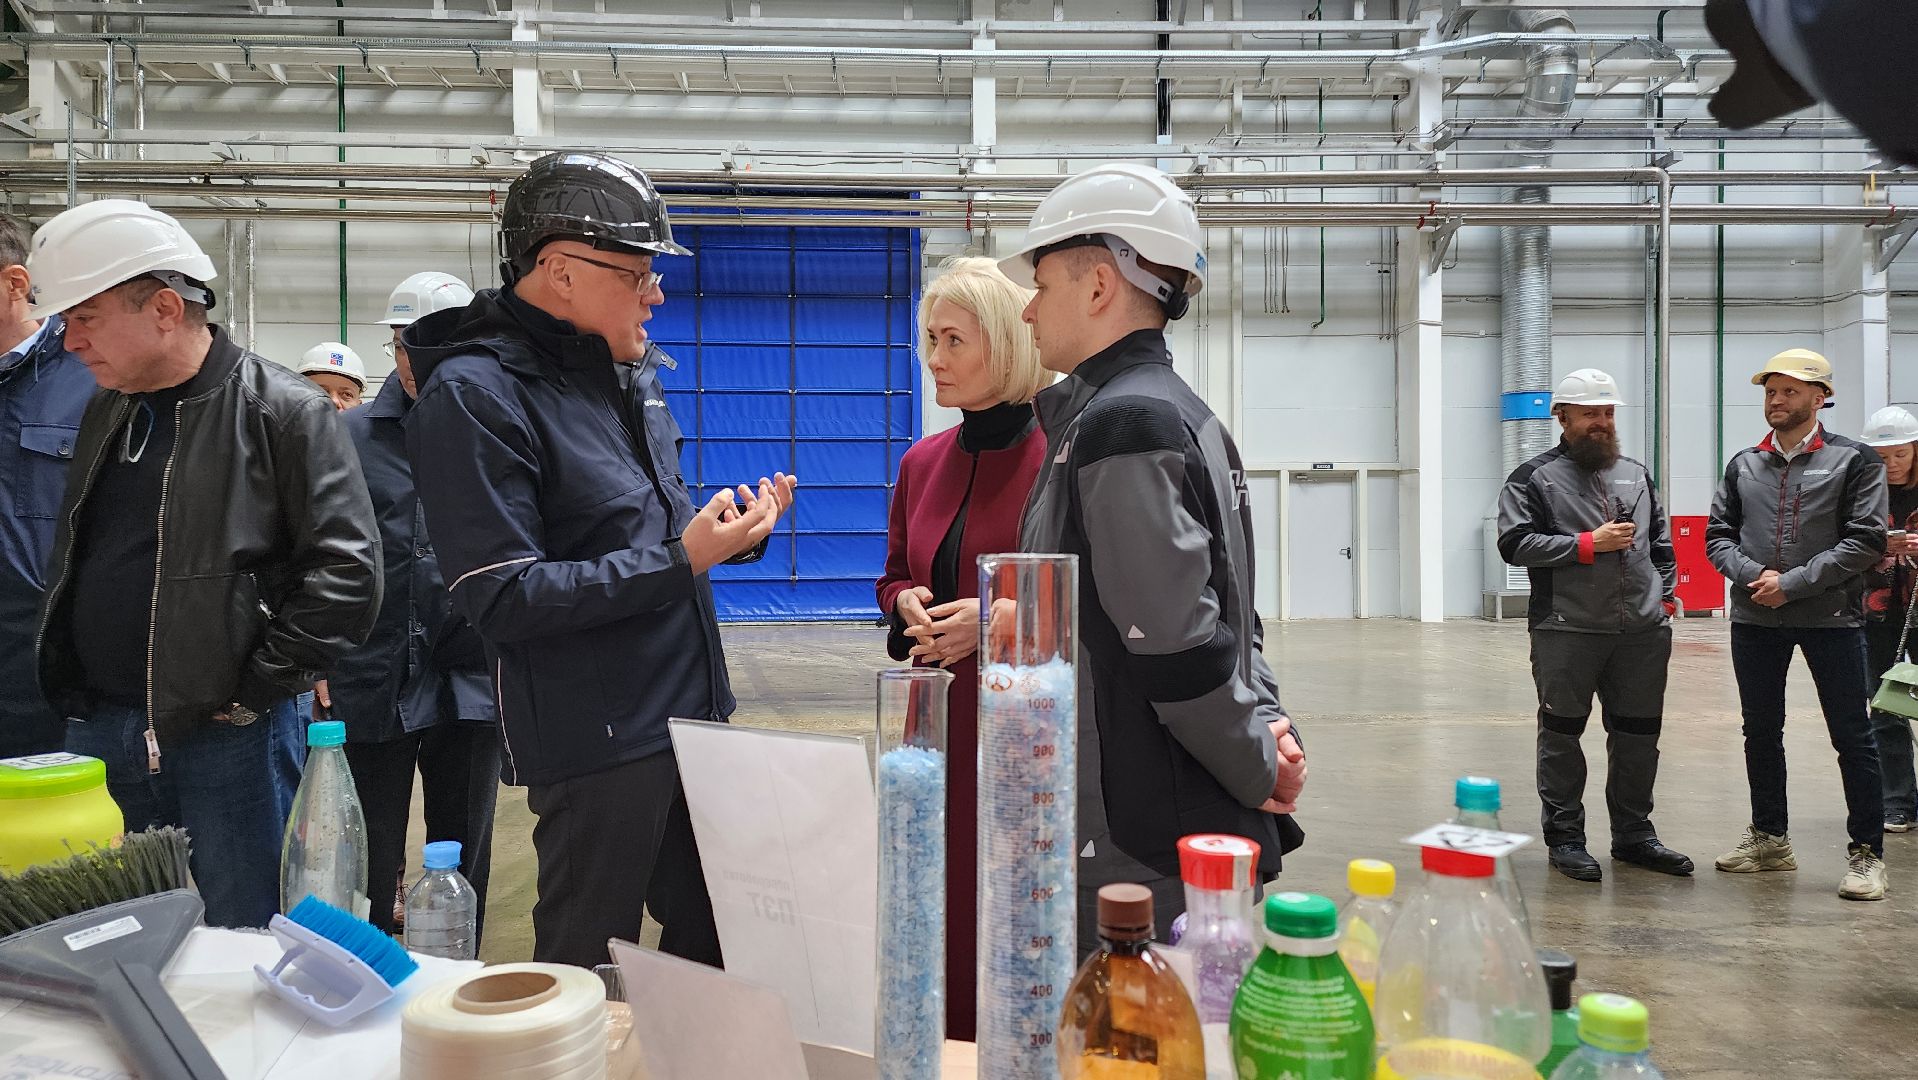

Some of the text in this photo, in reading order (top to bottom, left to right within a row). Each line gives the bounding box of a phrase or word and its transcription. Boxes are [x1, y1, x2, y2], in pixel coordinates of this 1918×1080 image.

[1028, 697, 1056, 710] 1000
[1032, 791, 1055, 804] 800
[1032, 839, 1054, 852] 700
[1031, 887, 1054, 900] 600
[1031, 935, 1053, 948] 500
[1030, 983, 1053, 997] 400
[1030, 1032, 1053, 1046] 300
